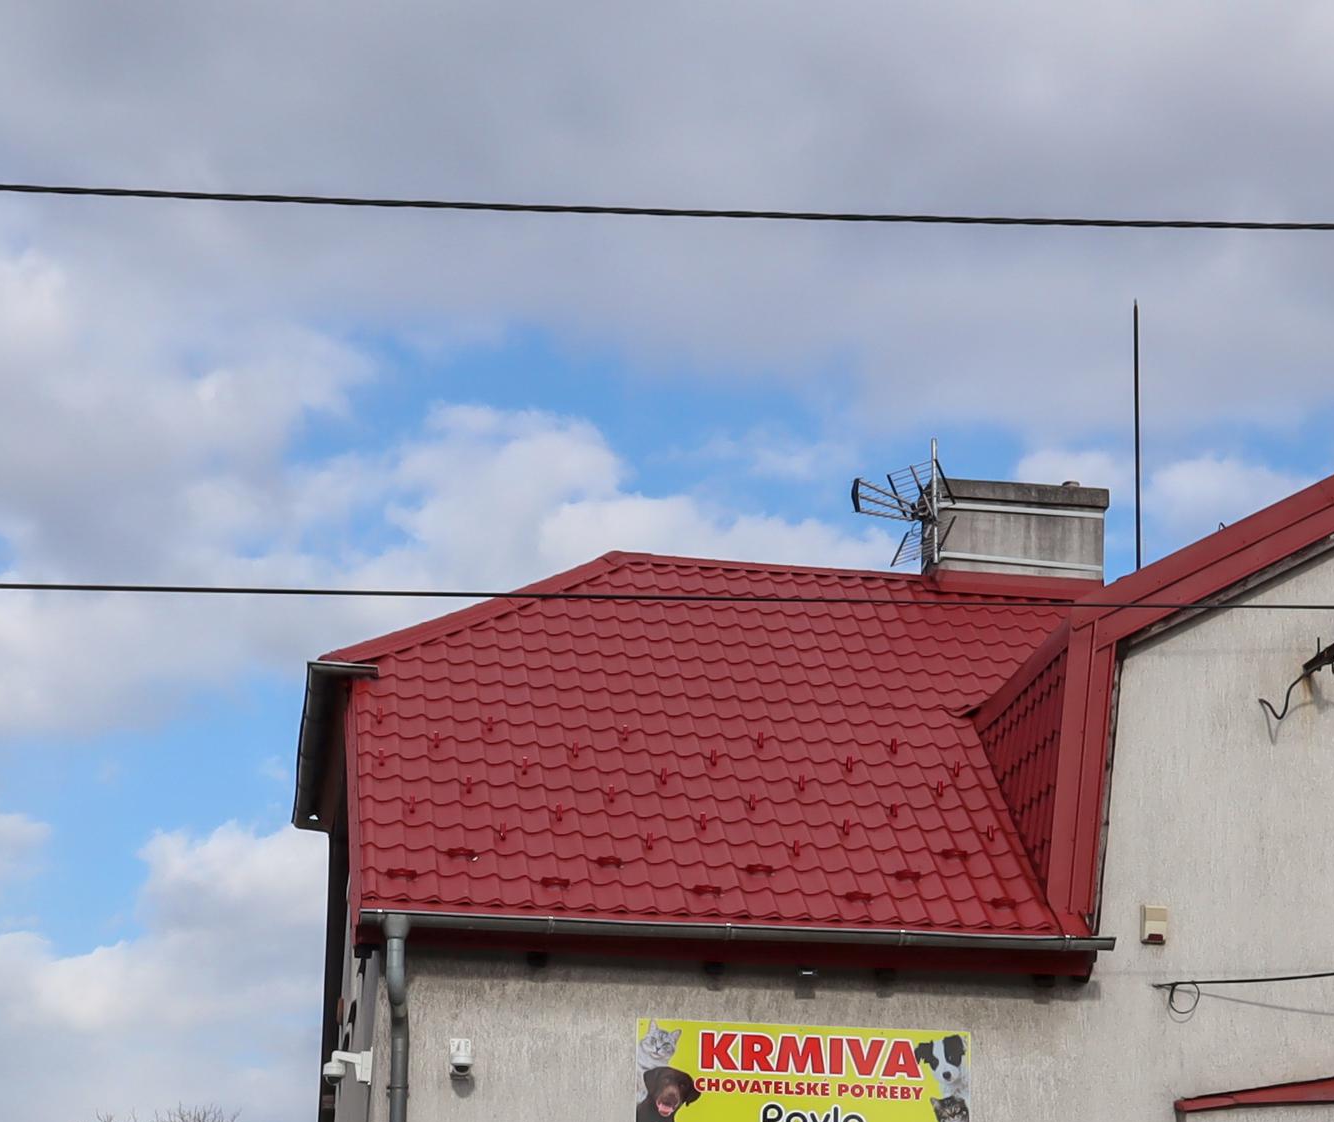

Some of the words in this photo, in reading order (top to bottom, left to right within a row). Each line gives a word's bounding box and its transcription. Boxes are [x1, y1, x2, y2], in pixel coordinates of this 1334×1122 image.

[700, 1031, 922, 1079] KRMIVA
[695, 1077, 830, 1097] CHOVATELSKÉ
[837, 1081, 924, 1100] POTŘEBY
